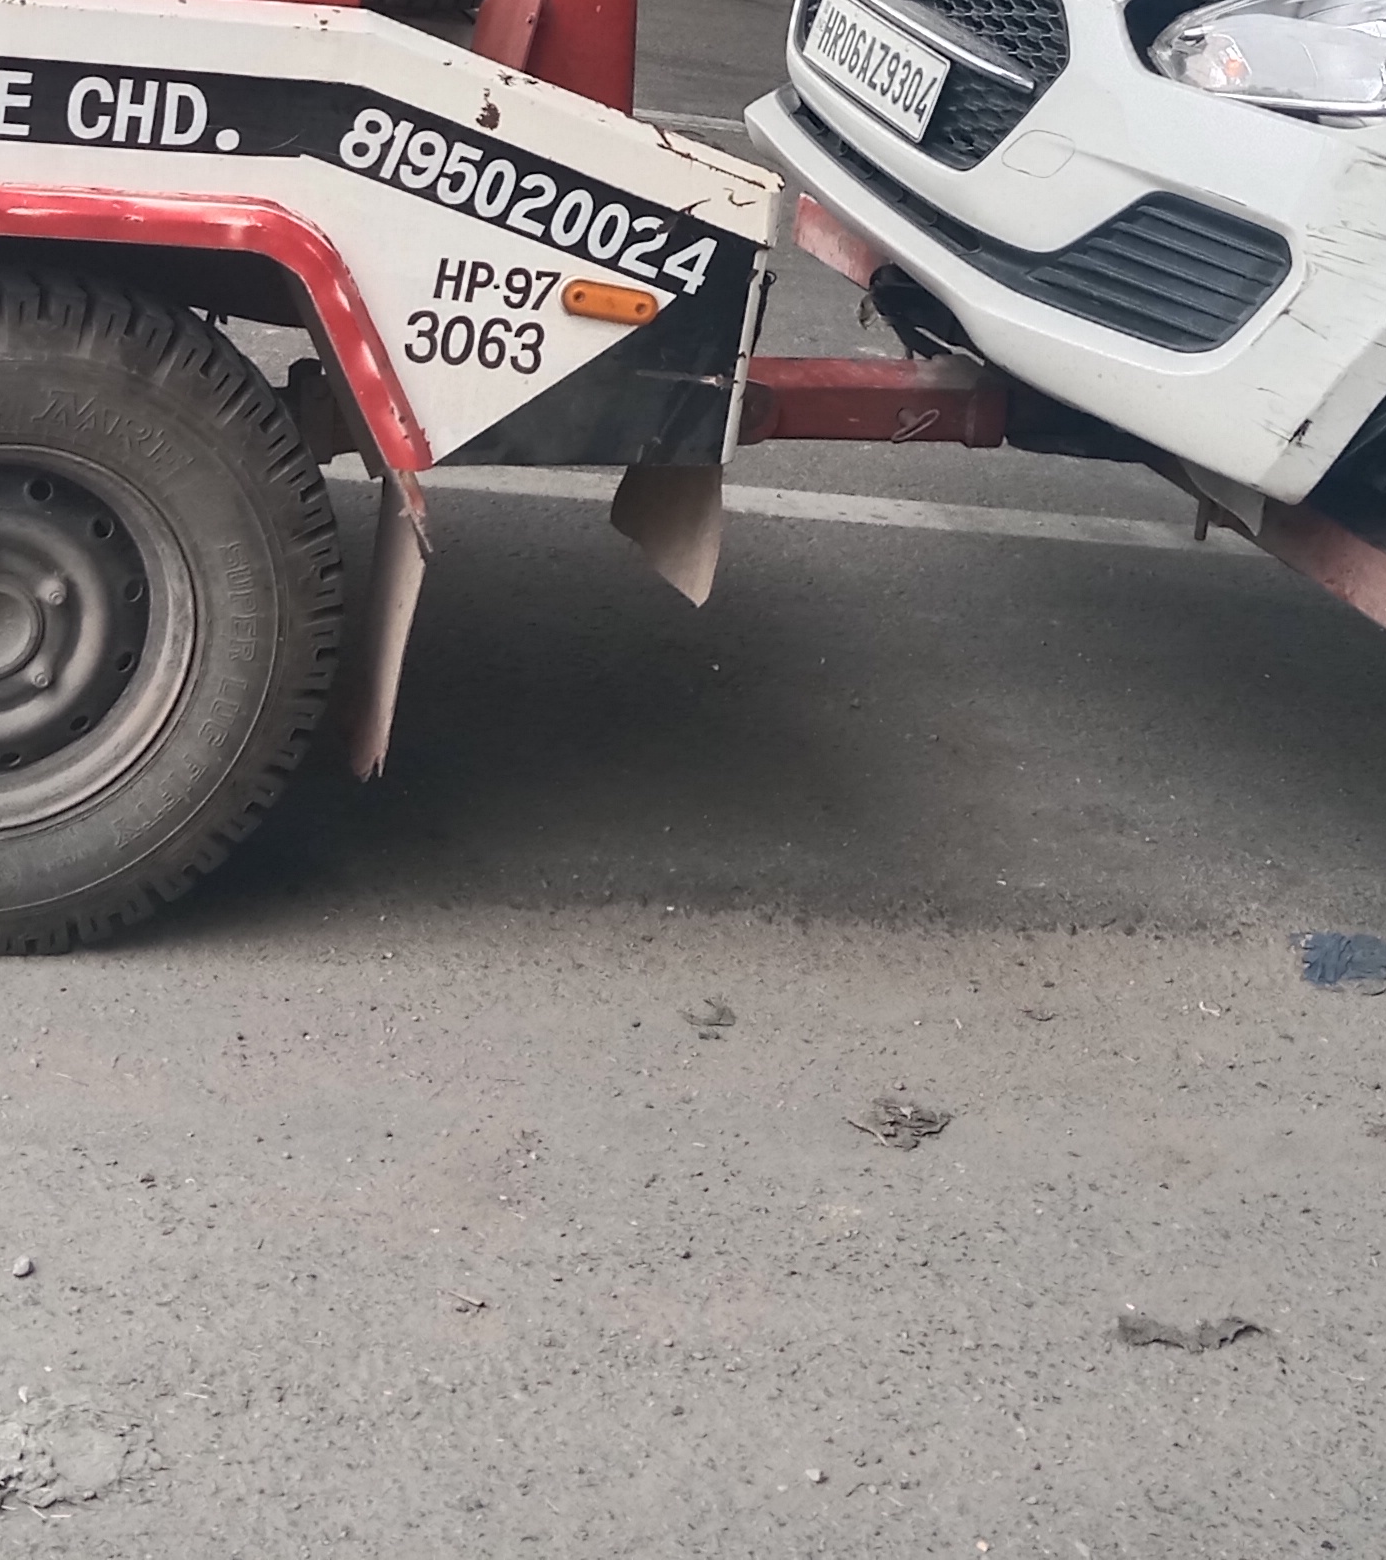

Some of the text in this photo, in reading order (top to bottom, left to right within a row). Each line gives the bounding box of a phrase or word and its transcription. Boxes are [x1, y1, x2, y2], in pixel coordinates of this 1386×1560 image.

[66, 76, 241, 150] CHD.
[817, 6, 937, 123] HR06AZ9304
[338, 106, 719, 297] 8195020024
[405, 310, 544, 374] 3063
[219, 542, 257, 662] SUPER
